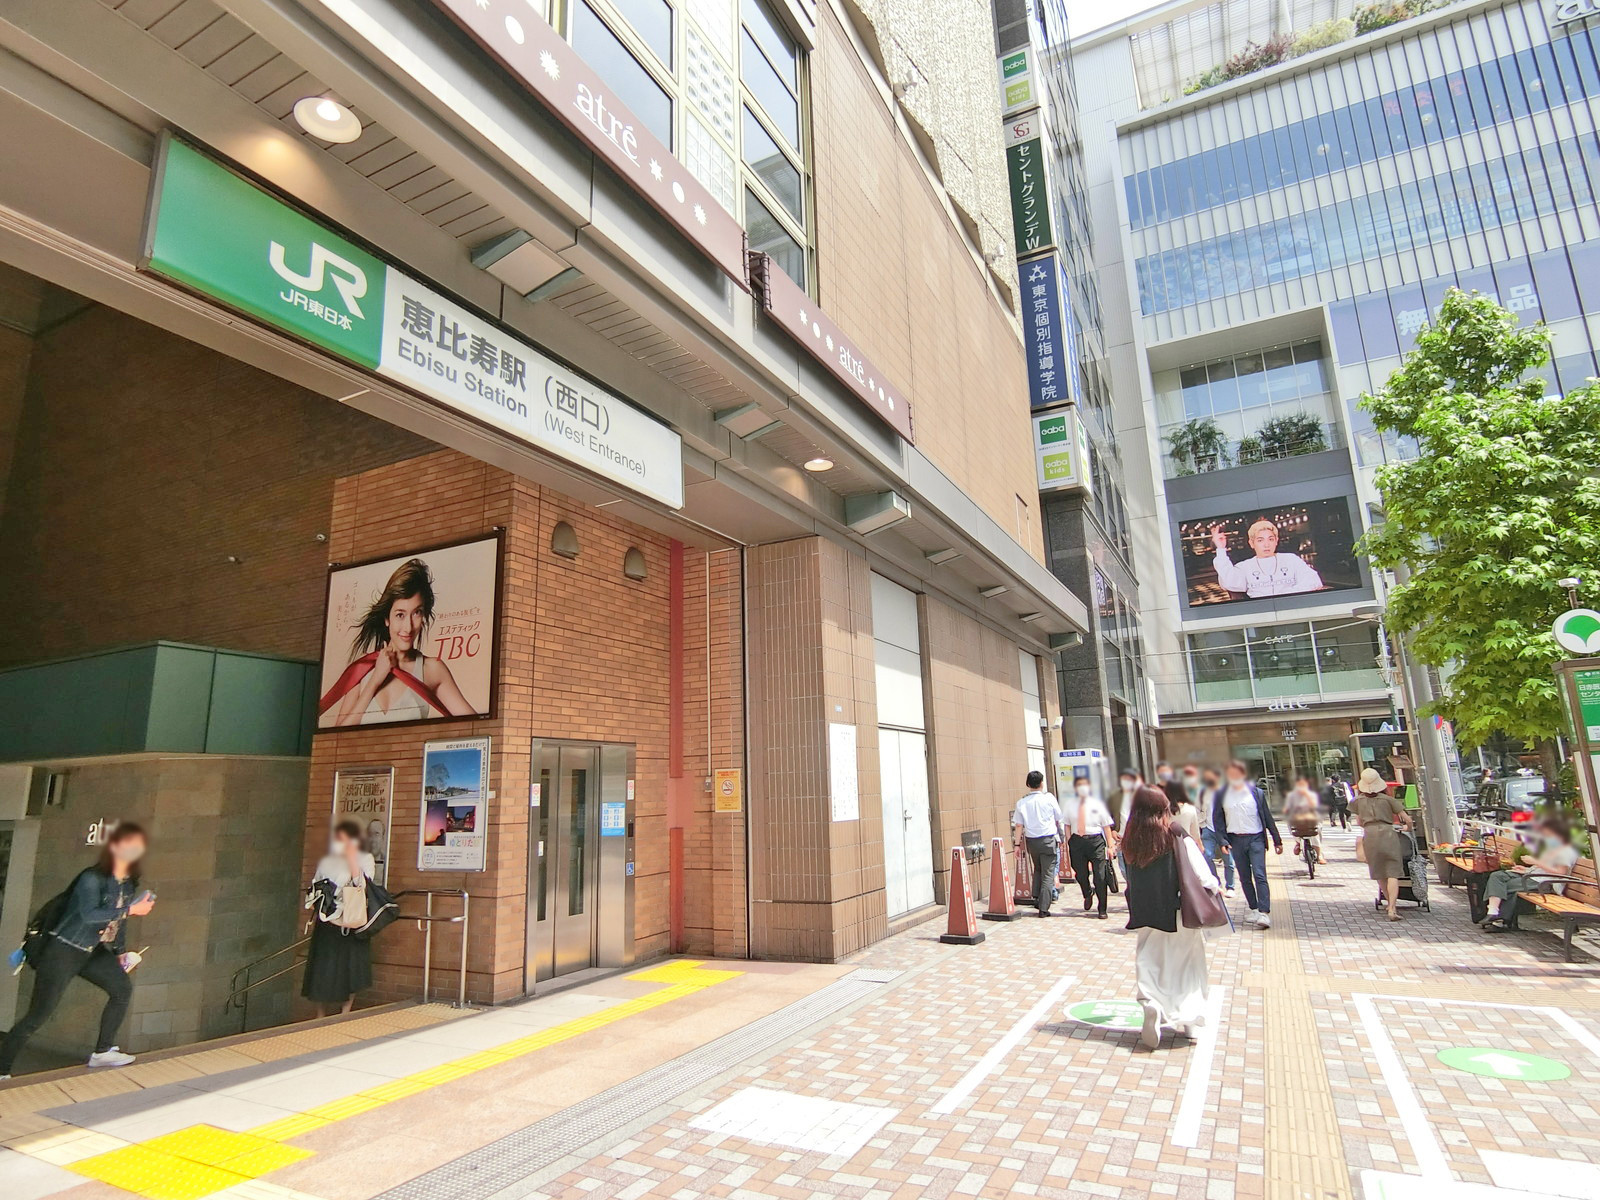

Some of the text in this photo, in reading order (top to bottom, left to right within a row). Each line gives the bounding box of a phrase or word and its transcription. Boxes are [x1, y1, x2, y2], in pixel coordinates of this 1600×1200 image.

[574, 81, 640, 164] atré
[1017, 145, 1040, 250] セントグランデW
[269, 239, 368, 320] JR
[279, 288, 353, 332] JR東日本
[1396, 283, 1540, 336] 無品
[400, 295, 527, 393] 恵比寿駅
[839, 346, 865, 382] atré
[1031, 283, 1058, 400] 東京個別指導学院
[397, 342, 646, 477] Ebisu Station (West Entrance)
[1049, 466, 1066, 475] kids
[435, 633, 481, 661] TBC
[438, 620, 481, 636] エステティック
